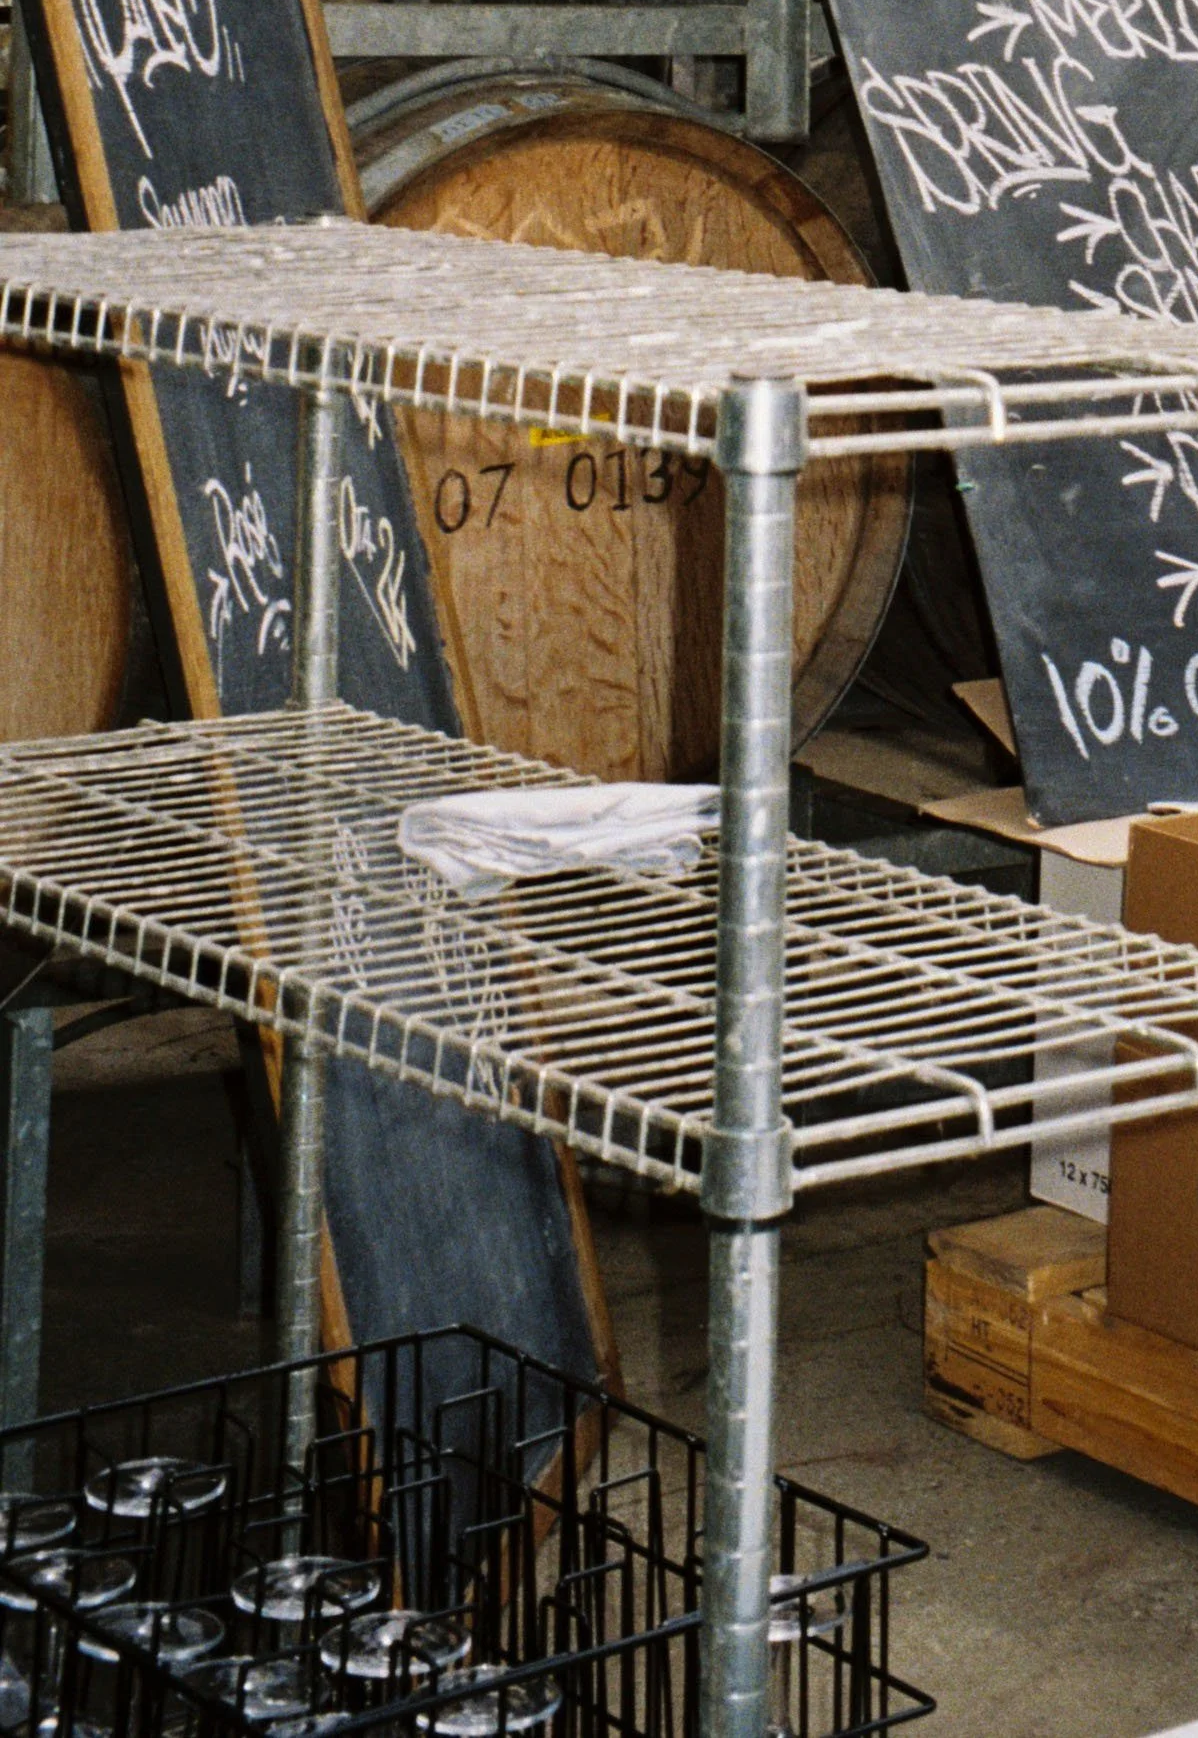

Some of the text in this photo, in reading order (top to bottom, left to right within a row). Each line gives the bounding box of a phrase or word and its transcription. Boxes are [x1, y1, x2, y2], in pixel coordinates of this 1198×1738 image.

[862, 58, 1154, 213] SPRING
[434, 463, 516, 534] 07
[1041, 636, 1180, 761] 10%
[1060, 1160, 1076, 1181] 12
